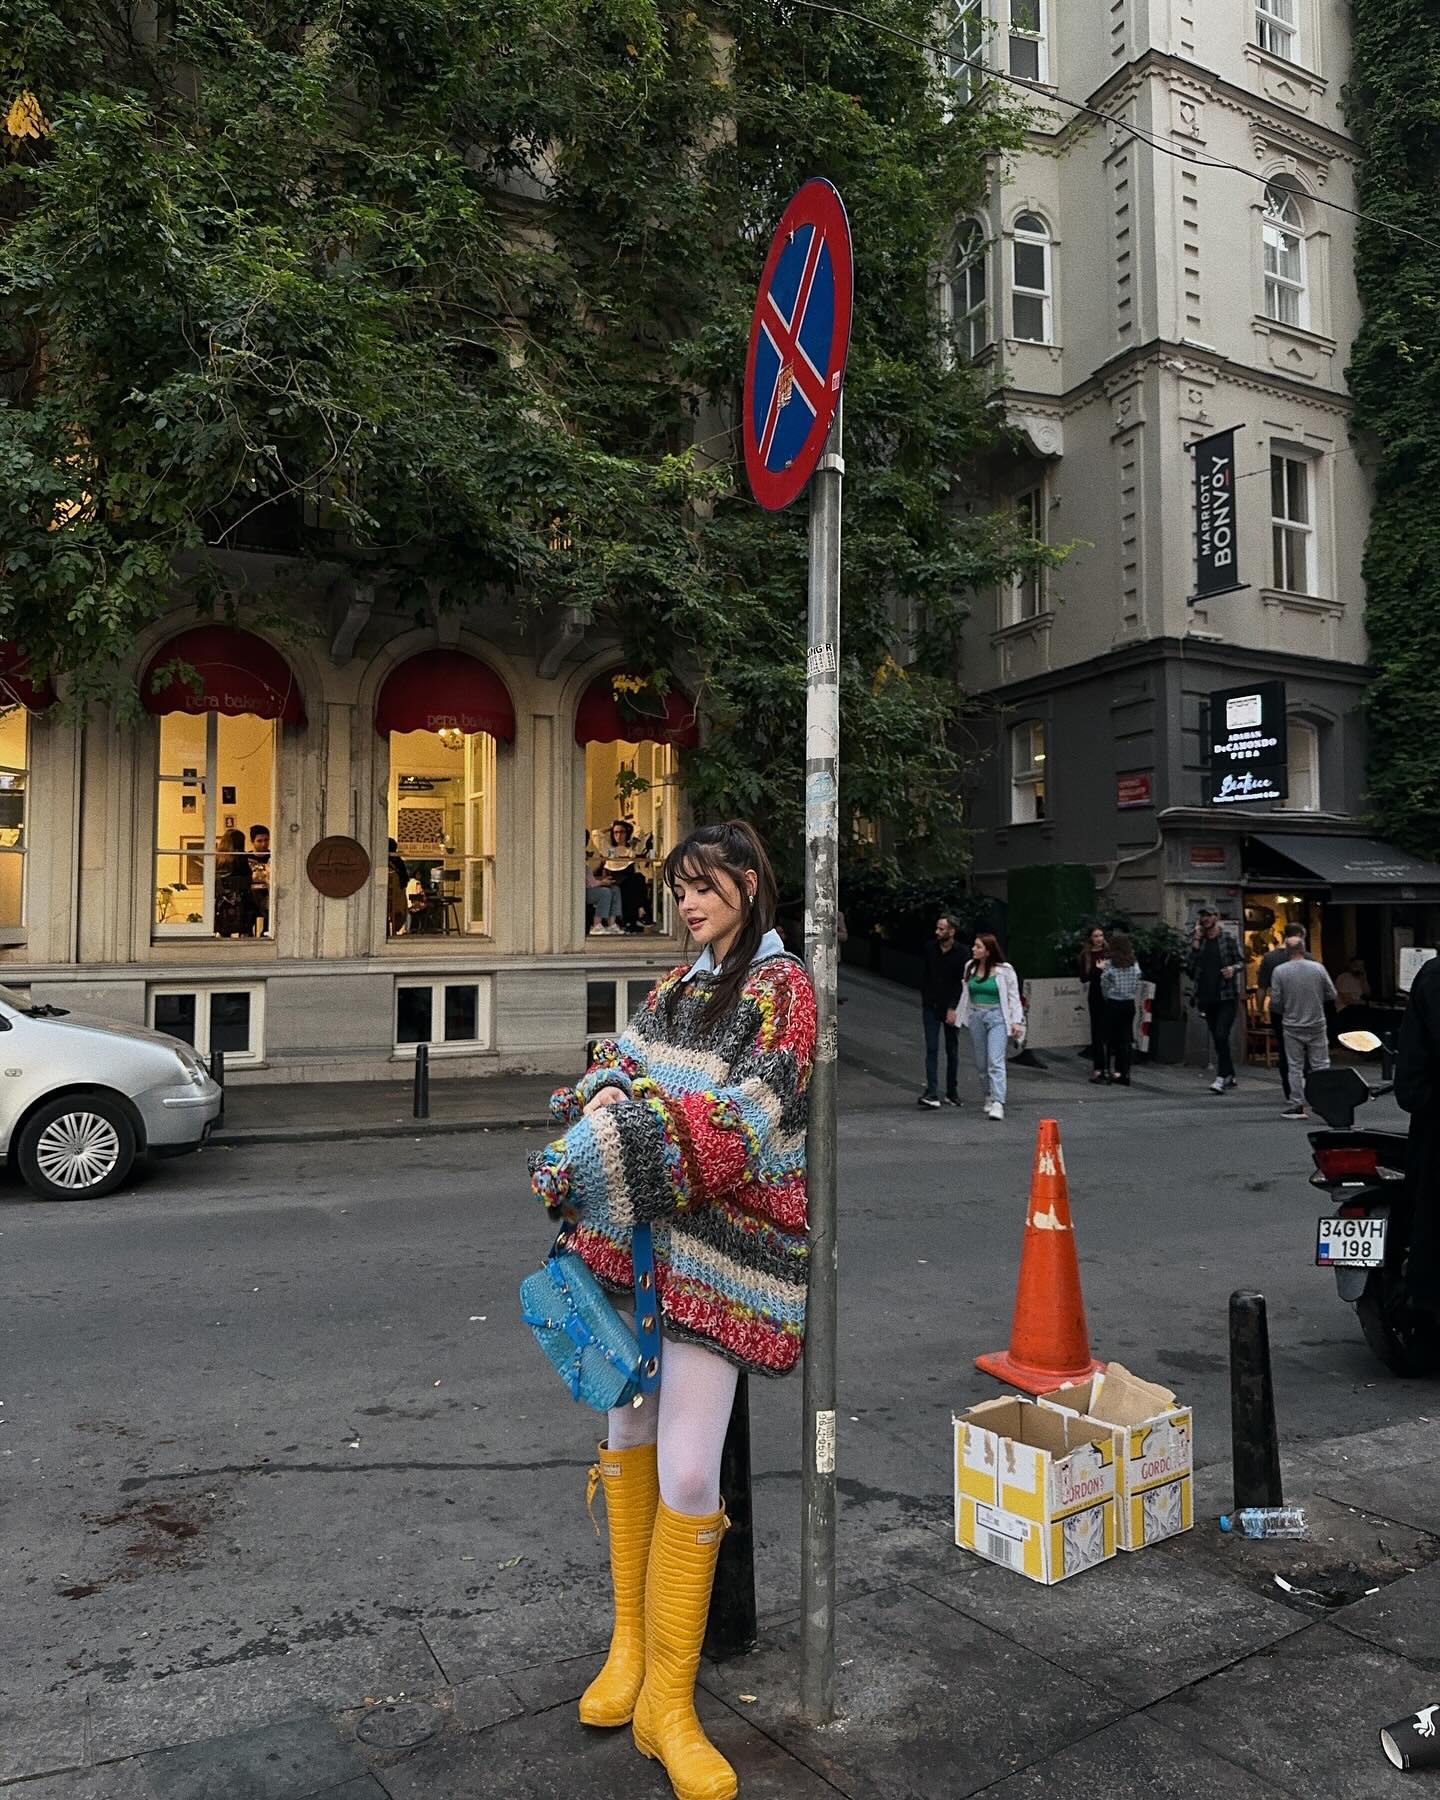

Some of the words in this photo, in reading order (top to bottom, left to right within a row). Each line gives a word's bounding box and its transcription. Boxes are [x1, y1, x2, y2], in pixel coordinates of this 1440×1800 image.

[1200, 474, 1211, 556] MARRIOTT
[1211, 455, 1232, 568] BONVOY
[427, 714, 457, 729] pera
[1230, 750, 1260, 760] PERA
[1321, 1220, 1383, 1238] 34GVH
[1341, 1240, 1372, 1257] 198
